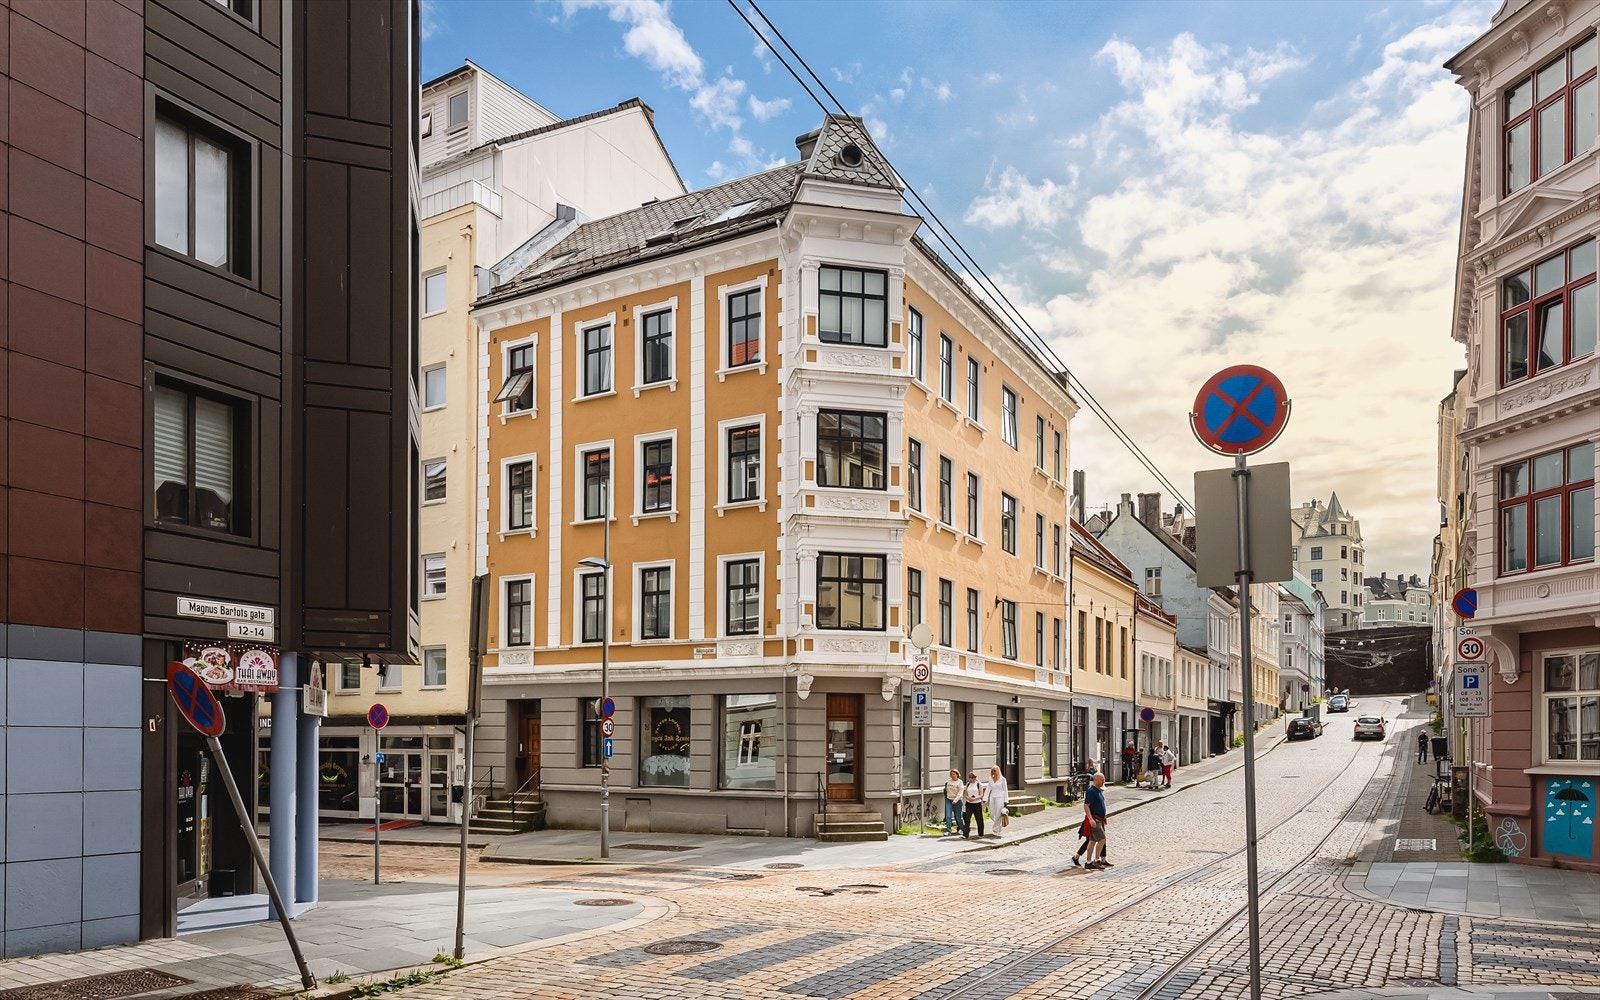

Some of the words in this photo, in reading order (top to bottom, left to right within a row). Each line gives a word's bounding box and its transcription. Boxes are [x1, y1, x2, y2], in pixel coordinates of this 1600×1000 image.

[189, 602, 217, 614] Magnus
[250, 611, 265, 620] gate
[238, 626, 264, 637] 12-14
[1460, 627, 1477, 635] Son
[1463, 643, 1479, 654] 30
[238, 668, 254, 679] THAI
[256, 669, 276, 680] AWAY
[917, 668, 926, 677] 30
[604, 722, 612, 733] 30
